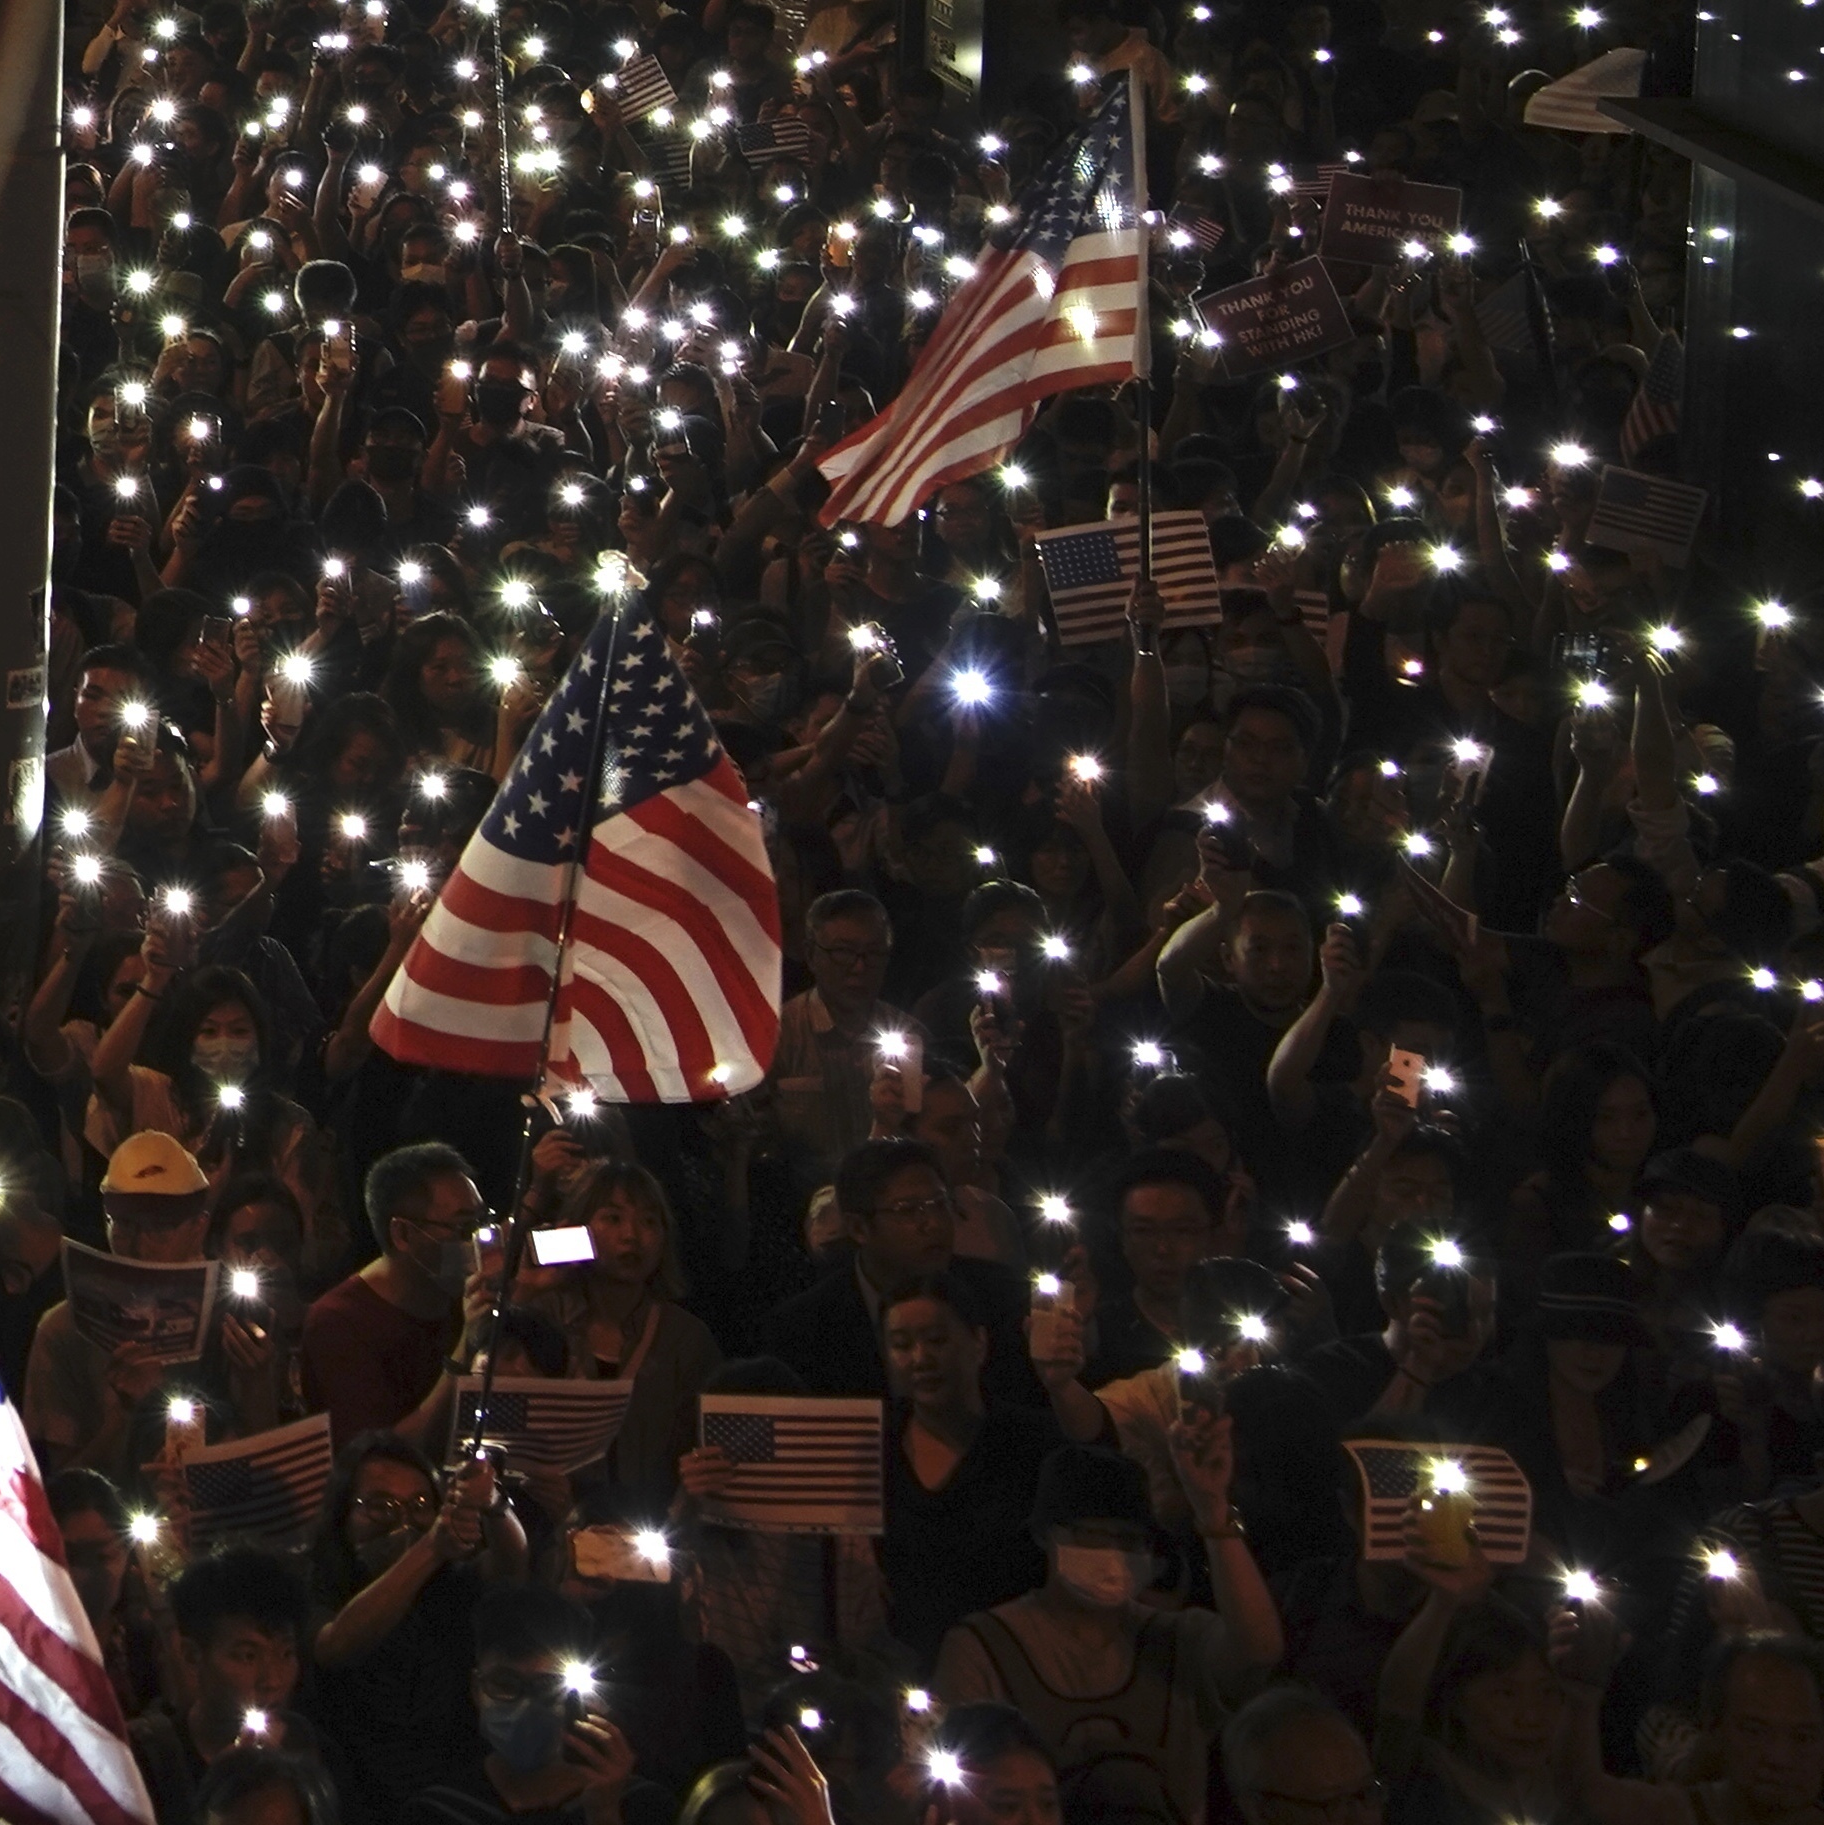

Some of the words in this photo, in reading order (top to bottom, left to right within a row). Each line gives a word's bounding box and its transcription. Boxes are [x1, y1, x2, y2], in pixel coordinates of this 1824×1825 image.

[1345, 203, 1401, 222] THANK
[1408, 212, 1444, 228] YOU
[1217, 290, 1275, 316] THANK
[1282, 277, 1315, 299] YOU
[1237, 308, 1321, 344] STANDING
[1256, 304, 1290, 322] FOR
[1245, 336, 1290, 357] WITH
[1294, 325, 1324, 345] HK!
